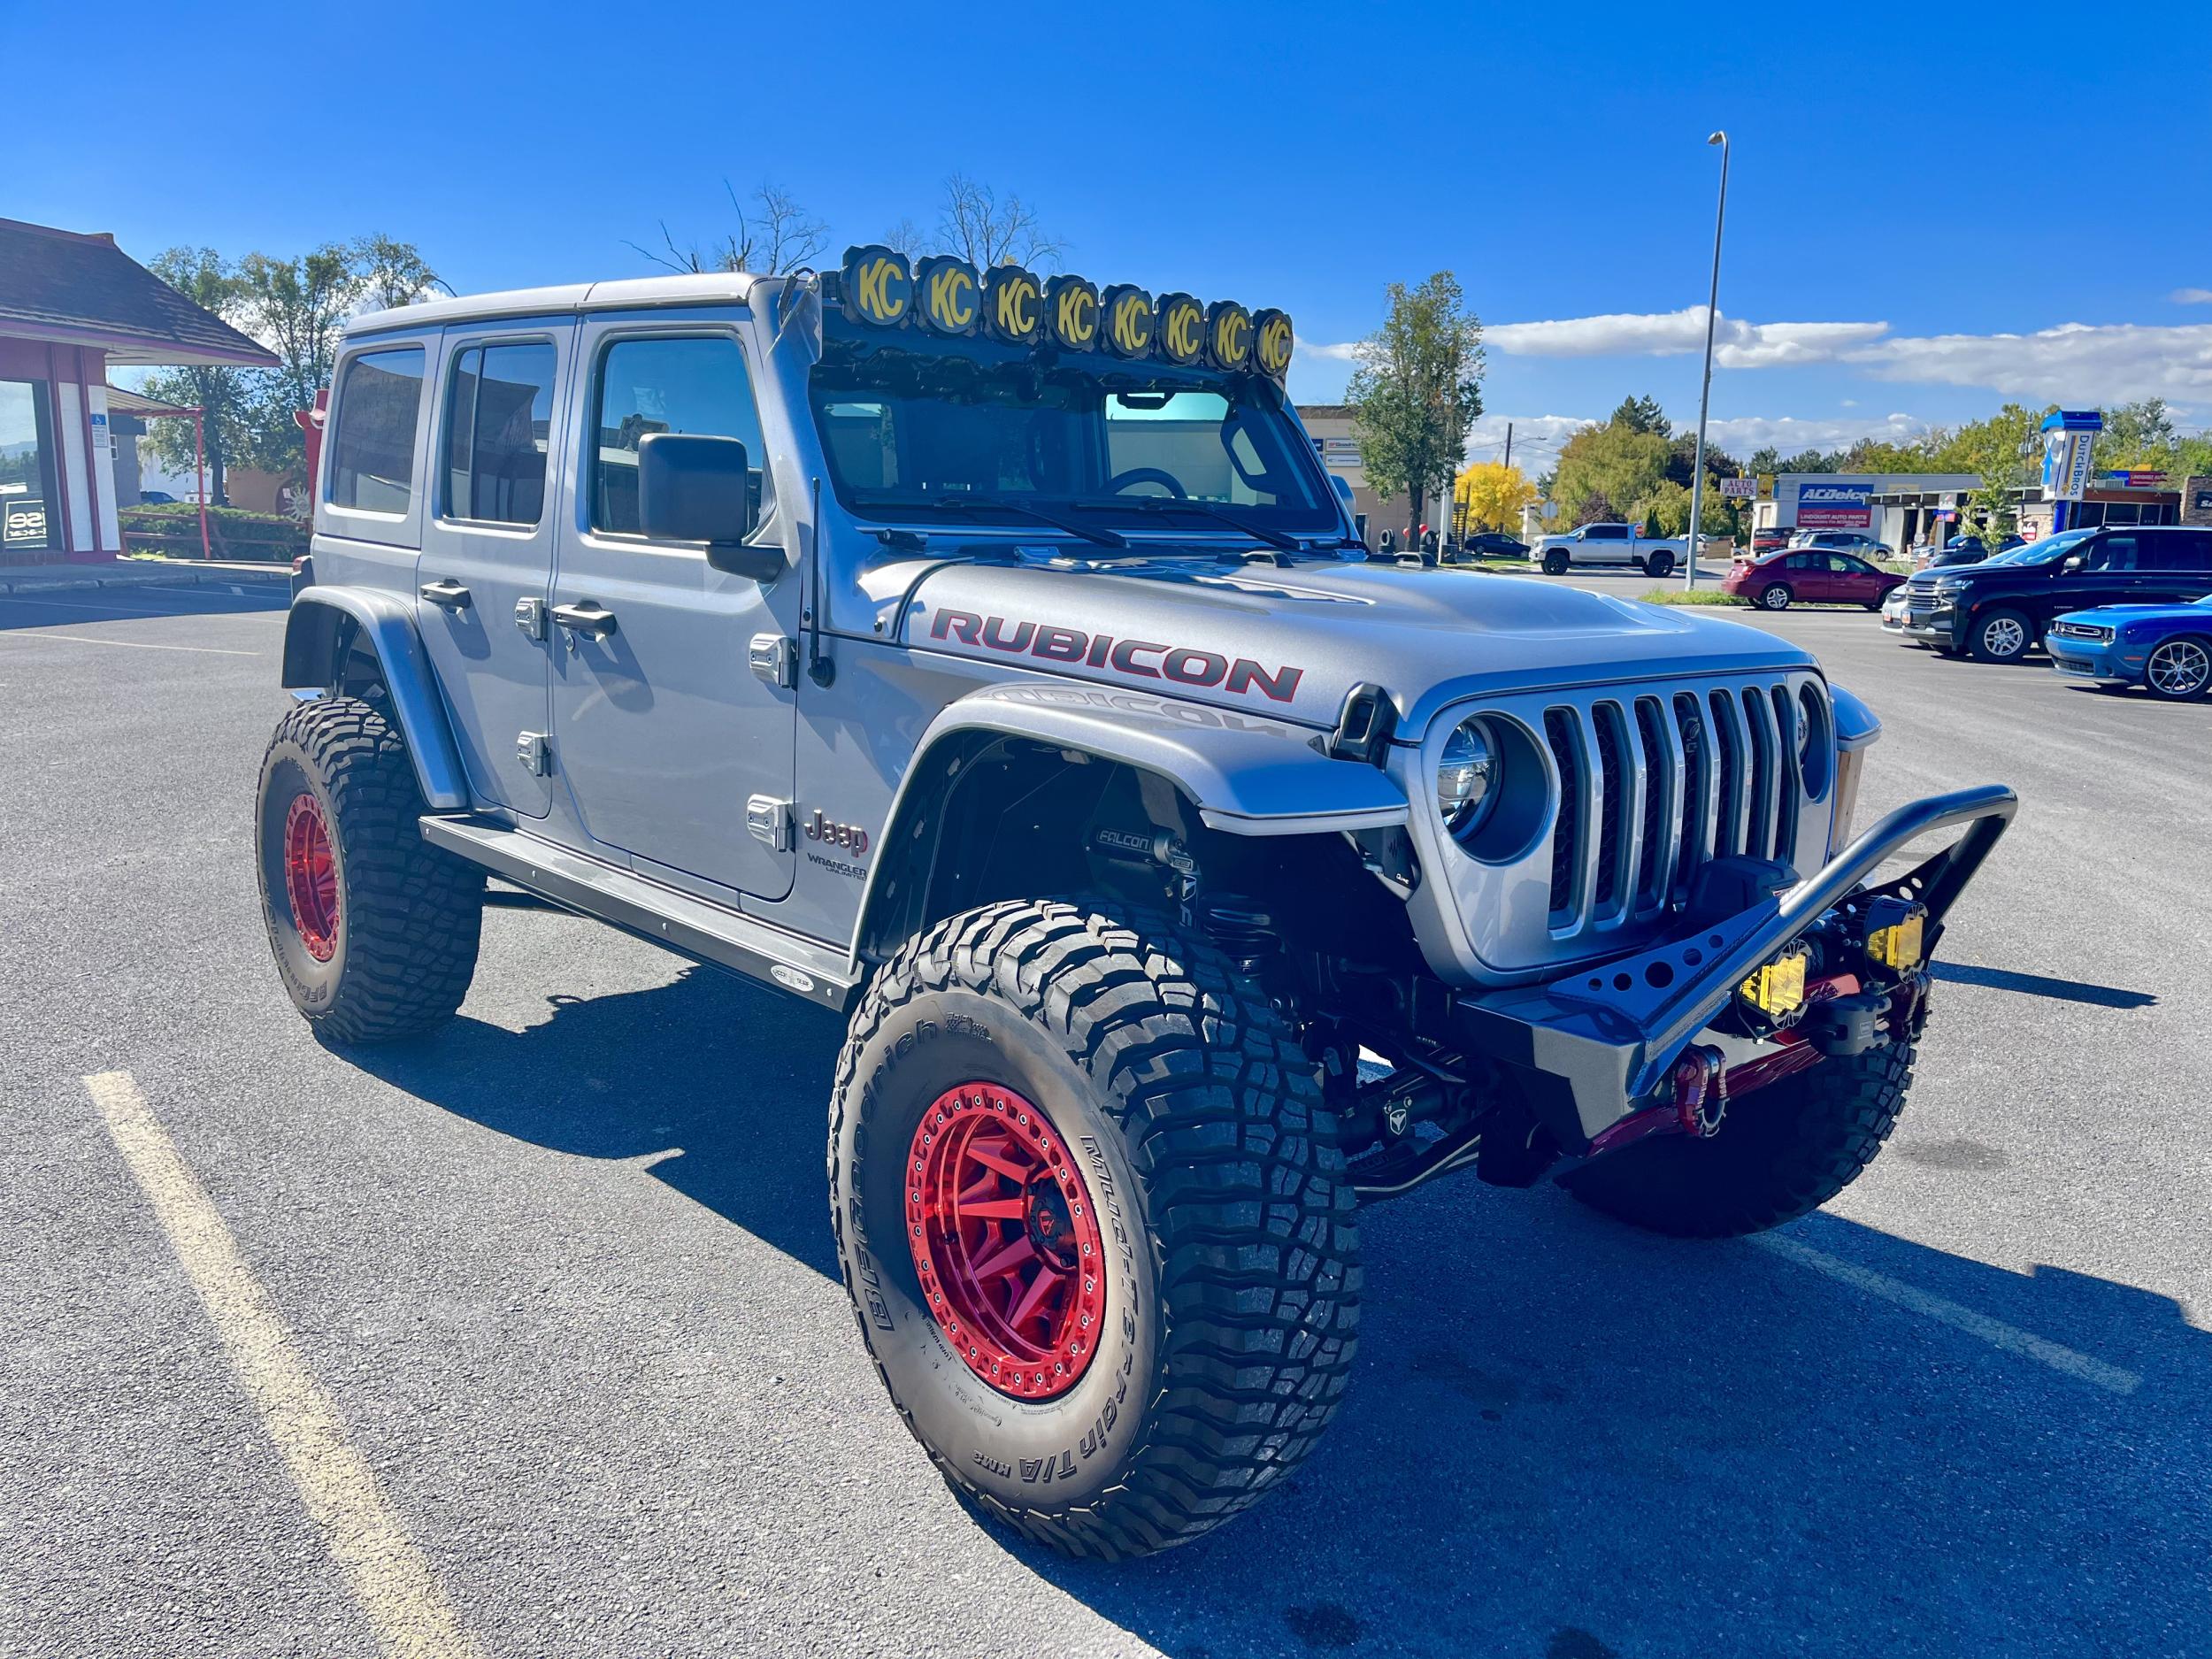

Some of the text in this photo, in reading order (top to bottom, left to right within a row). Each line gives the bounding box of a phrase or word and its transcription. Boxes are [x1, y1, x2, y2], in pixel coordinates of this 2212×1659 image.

[859, 258, 902, 319] KC
[931, 268, 972, 328] KC
[997, 278, 1035, 336] KC
[1057, 287, 1094, 343] KC
[1115, 296, 1148, 350] KC
[1168, 304, 1200, 357] KC
[1217, 311, 1247, 364] KC
[1262, 319, 1290, 369] KC
[2070, 435, 2089, 495] DUTCH BROS
[930, 608, 1303, 703] RUBICON
[804, 809, 868, 858] Jeep
[1099, 830, 1149, 850] FALCON
[807, 852, 867, 877] WRANGLER
[826, 866, 867, 881] UNLIMITED
[849, 1018, 937, 1331] BFGoodrich
[1079, 1135, 1139, 1459] Mud-Terrain
[973, 1450, 1011, 1479] KM3
[1019, 1448, 1078, 1484] T/A
